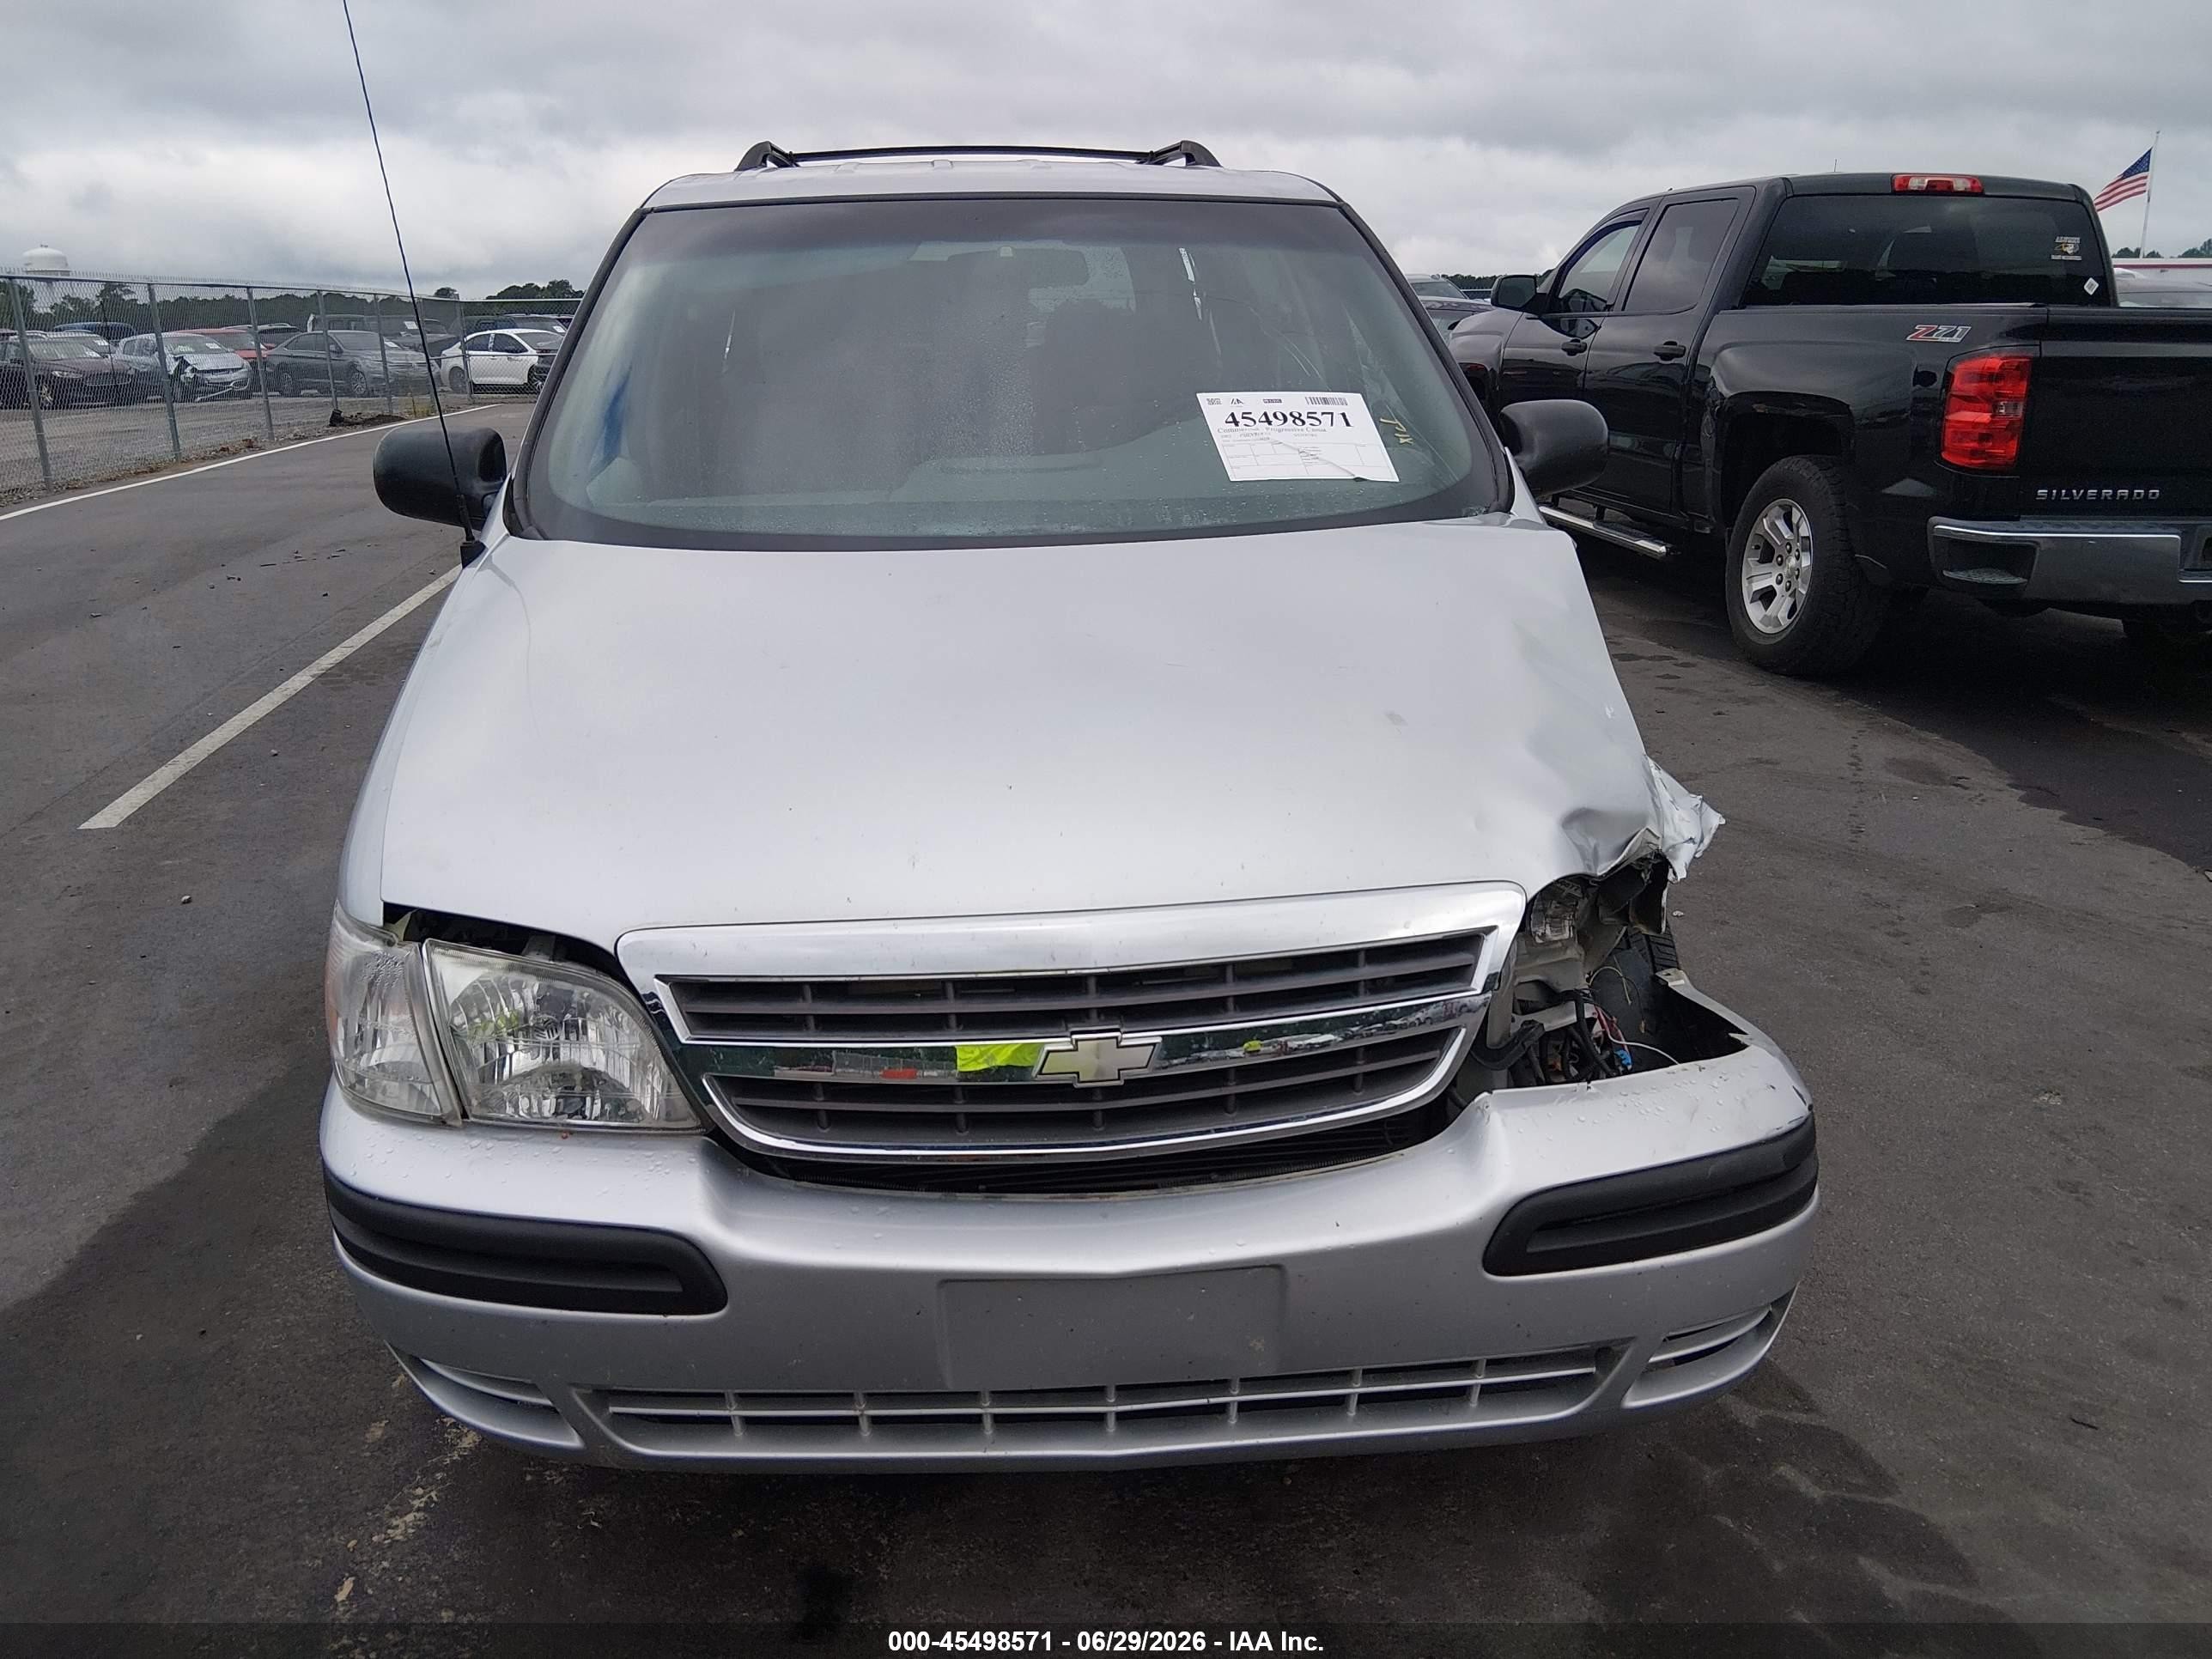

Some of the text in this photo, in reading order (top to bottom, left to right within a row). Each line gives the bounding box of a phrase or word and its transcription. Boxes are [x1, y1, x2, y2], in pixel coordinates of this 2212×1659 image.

[1905, 325, 1972, 343] Z71
[1224, 410, 1354, 428] 45498571
[2035, 489, 2160, 500] SILVERADO
